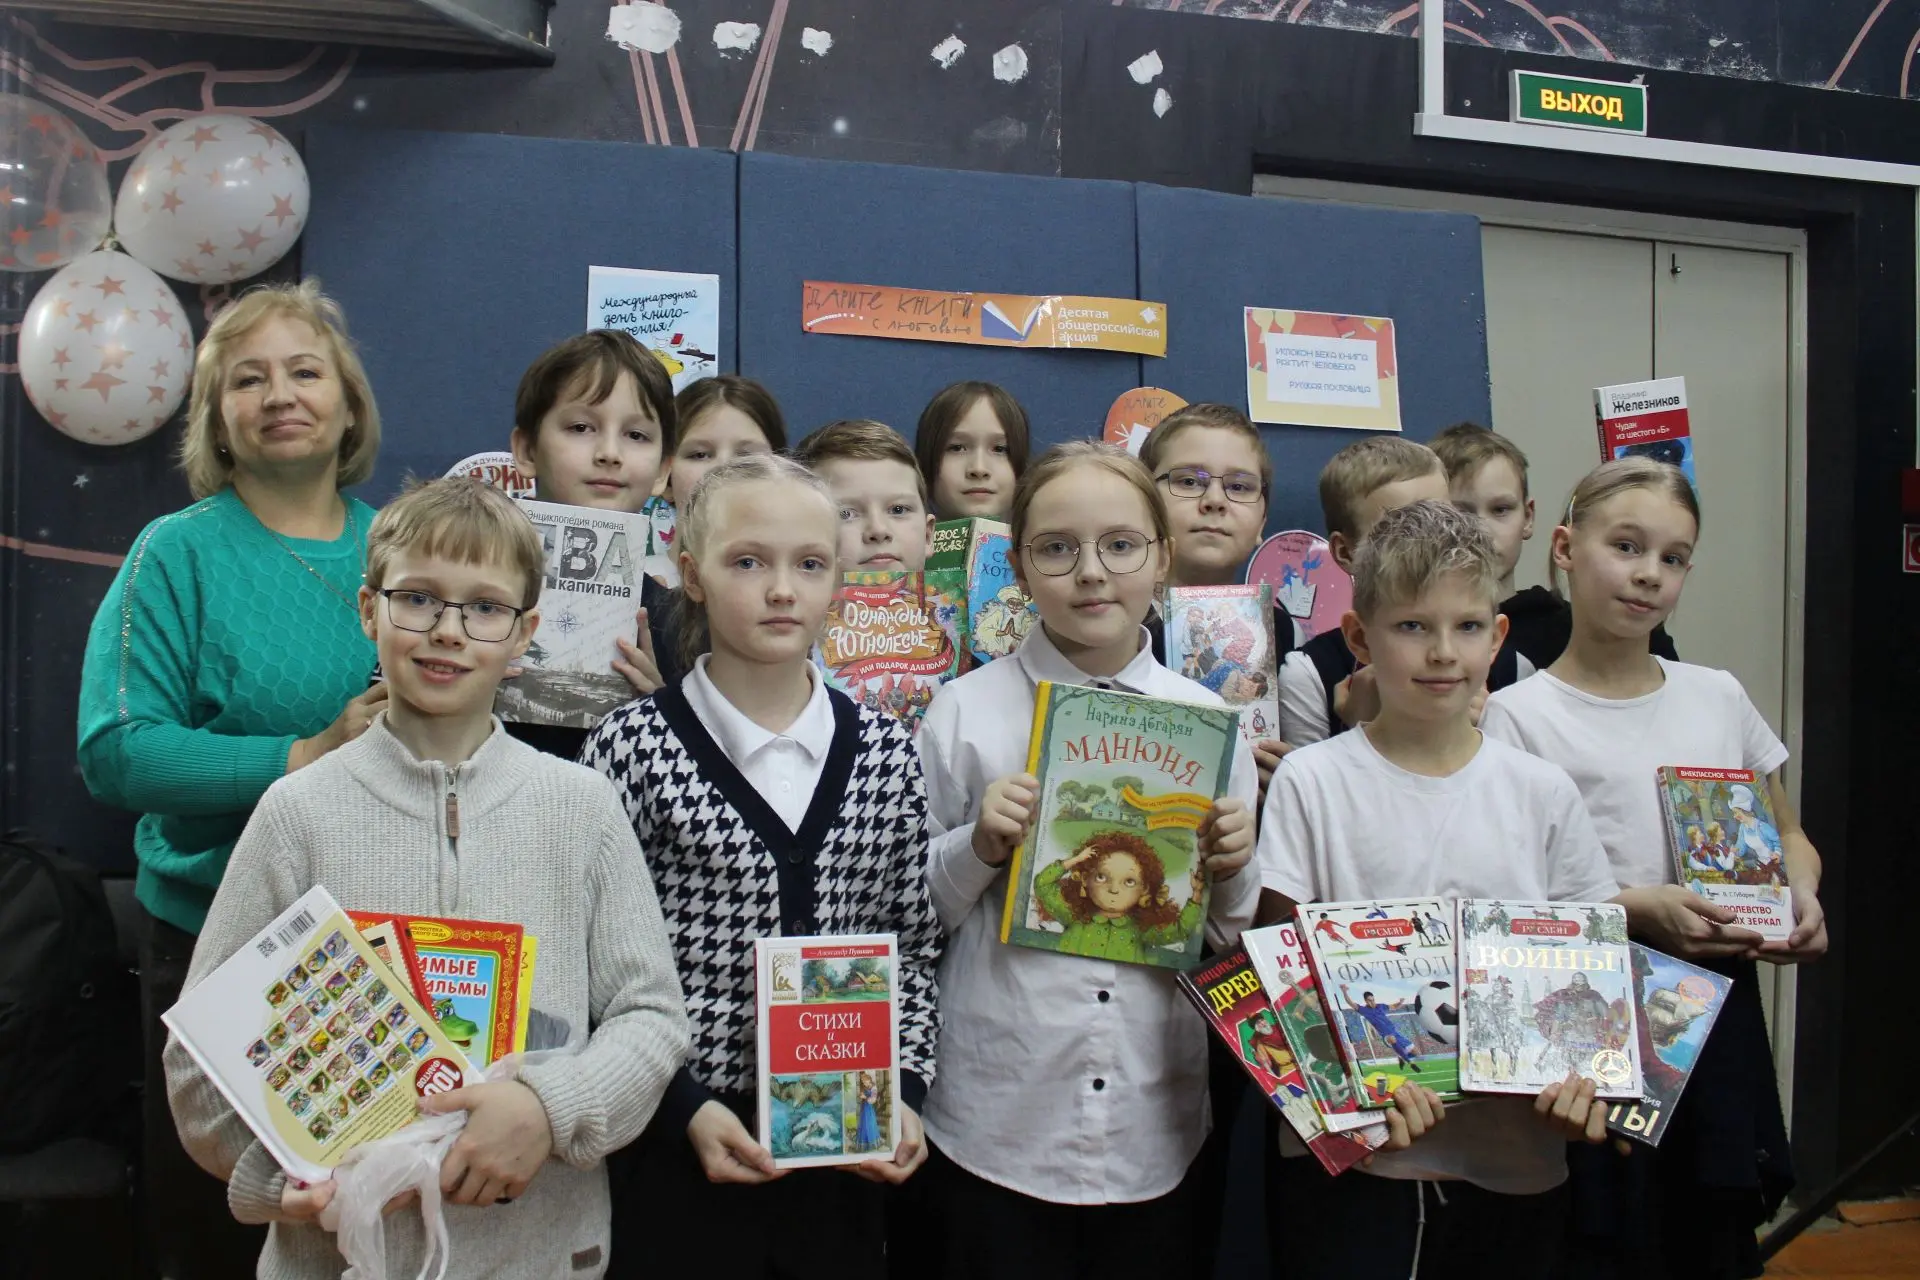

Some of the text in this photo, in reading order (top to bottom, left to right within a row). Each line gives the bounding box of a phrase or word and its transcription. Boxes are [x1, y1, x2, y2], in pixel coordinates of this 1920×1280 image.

[1541, 89, 1623, 121] ВЫХОД
[600, 289, 698, 311] Международный
[898, 294, 974, 319] КНИГИ
[604, 308, 688, 328] день книго-
[1058, 307, 1110, 320] Десятая
[1057, 320, 1160, 338] общероссийская
[1059, 332, 1098, 344] акция
[1338, 352, 1369, 361] КНИГА
[1311, 360, 1356, 371] ЧЕЛОВЕКА
[1289, 381, 1371, 394] РУССКАЯ ПОСЛОВИЦА
[1611, 390, 1647, 401] Владимир
[1613, 396, 1680, 413] Железников
[1615, 422, 1637, 432] Чудак
[1626, 429, 1656, 439] шестого
[527, 510, 624, 531] Энциклопедия романа
[558, 579, 631, 598] капитана
[860, 657, 947, 674] ИЛИ ПОДАРОК ДЛЯ ПОЛЛИ
[1086, 704, 1194, 739] Наринэ Абгарян
[1062, 732, 1204, 787] МАНЮНЯ
[1680, 770, 1750, 780] ВНЕКЛАССНОЕ ЧТЕНИЕ
[1748, 918, 1781, 926] ЗЕРКАЛ
[848, 948, 874, 956] Пушкин
[1338, 956, 1451, 983] ФУТБОЛ
[1207, 970, 1260, 1016] ДРЕВ
[827, 1032, 835, 1041] и
[795, 1042, 866, 1061] СКАЗКИ
[417, 1060, 441, 1089] ФАКТОВ
